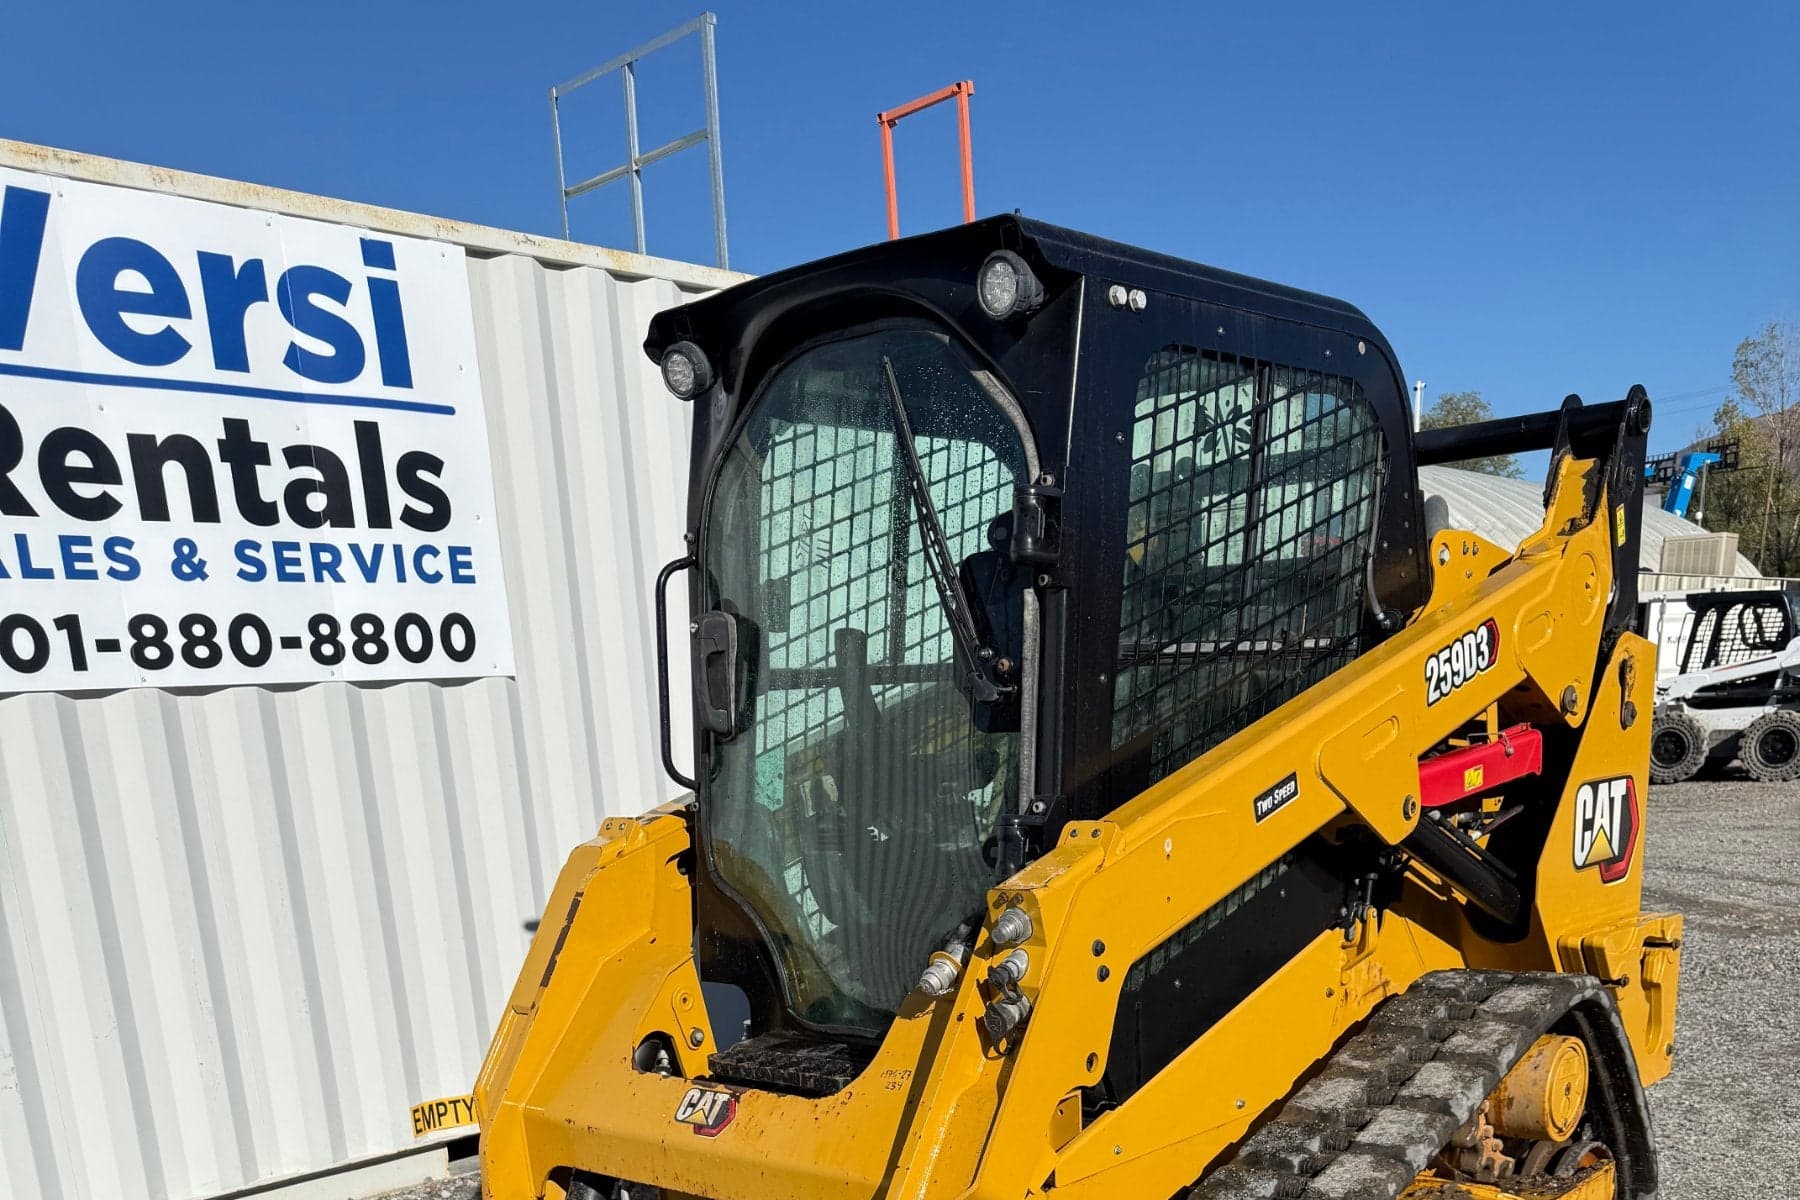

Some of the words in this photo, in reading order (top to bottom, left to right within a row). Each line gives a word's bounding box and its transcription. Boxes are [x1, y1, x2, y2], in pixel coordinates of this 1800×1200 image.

[0, 534, 140, 581] LES
[172, 538, 210, 582] &
[235, 540, 477, 584] SERVICE
[0, 613, 476, 673] 01-880-8800
[1426, 625, 1490, 704] 259D3
[1257, 796, 1273, 815] TWO
[1274, 781, 1295, 804] SPEED
[1574, 778, 1627, 867] CAT
[412, 1096, 474, 1134] EMPTY
[676, 1088, 732, 1126] CAT
